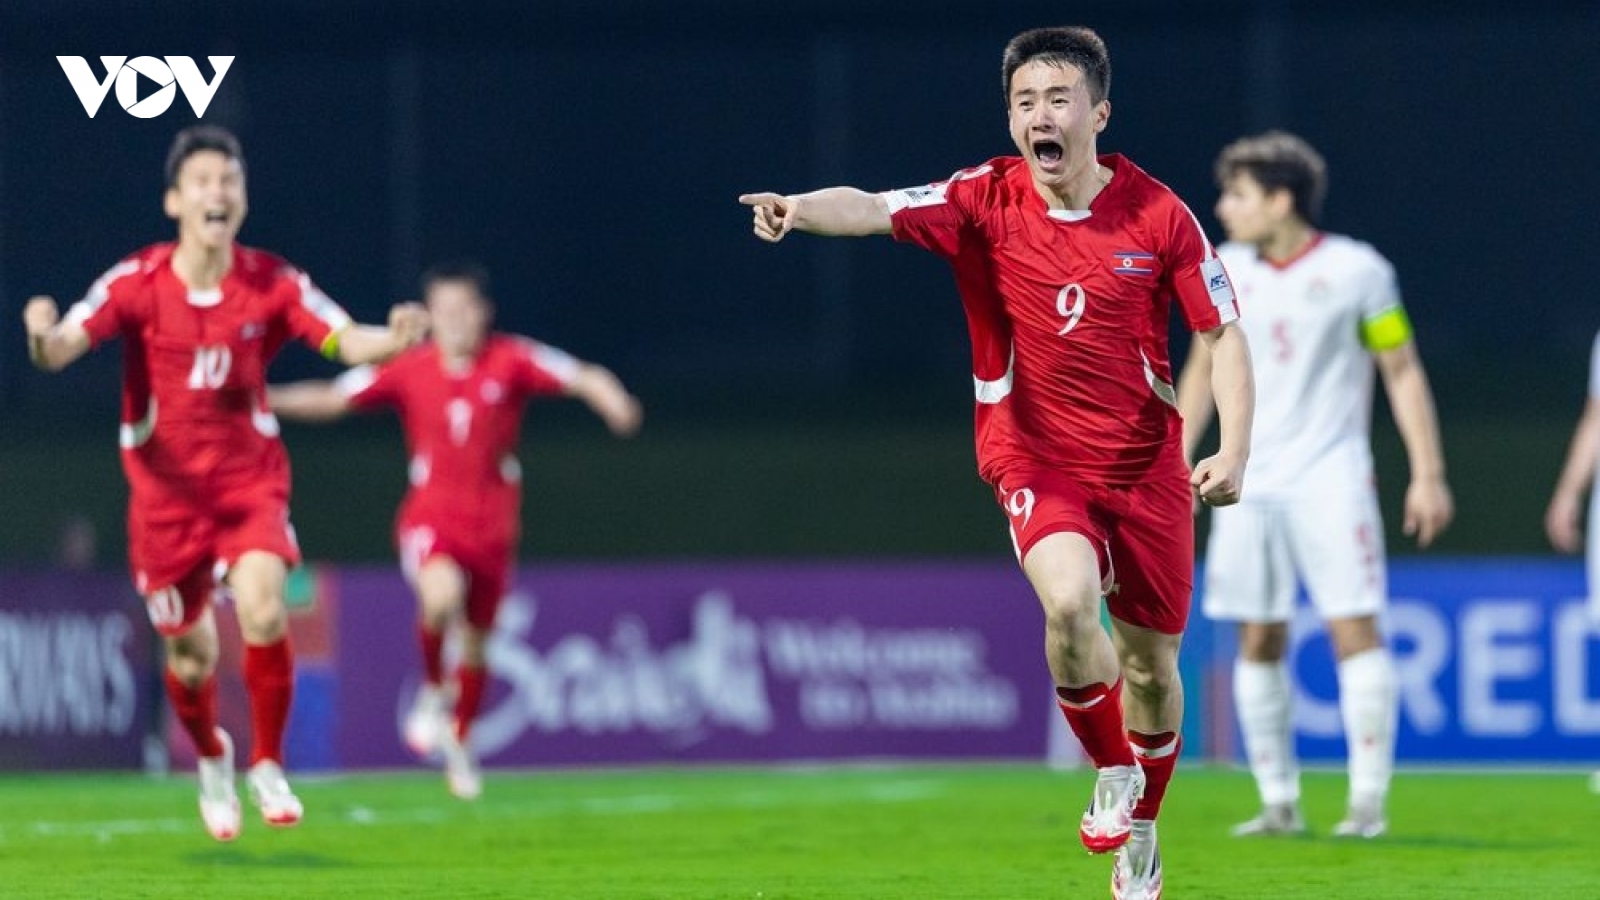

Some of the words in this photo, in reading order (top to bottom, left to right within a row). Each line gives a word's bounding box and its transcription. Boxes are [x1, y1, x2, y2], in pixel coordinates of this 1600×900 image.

[1056, 283, 1086, 336] 9
[188, 345, 232, 390] 10
[1010, 487, 1035, 530] 9
